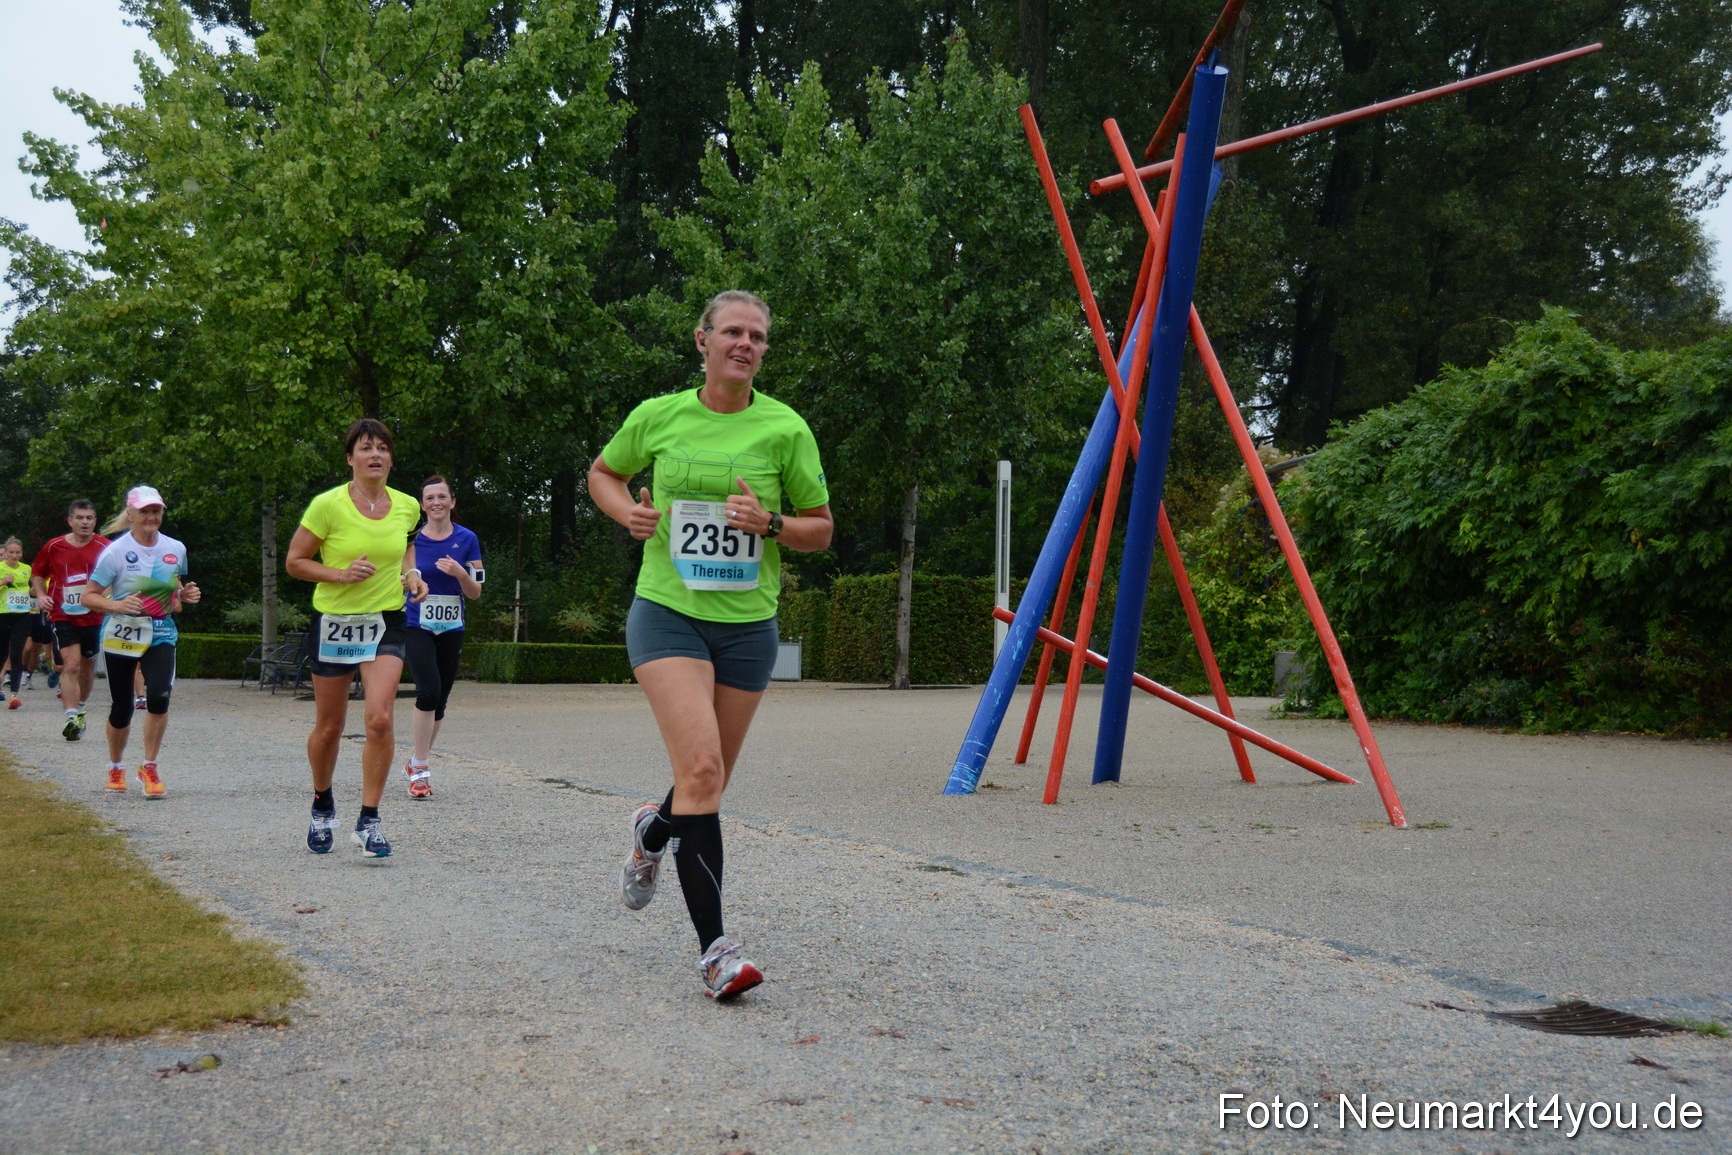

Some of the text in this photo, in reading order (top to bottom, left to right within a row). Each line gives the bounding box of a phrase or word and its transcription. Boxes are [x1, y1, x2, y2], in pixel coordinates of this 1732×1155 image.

[681, 523, 756, 557] 2351
[692, 564, 744, 579] Theresia
[9, 596, 29, 604] 2892
[67, 593, 81, 604] 07
[425, 605, 459, 620] 3063
[114, 624, 142, 641] 221
[328, 622, 378, 642] 2411
[337, 647, 366, 657] Brigitte
